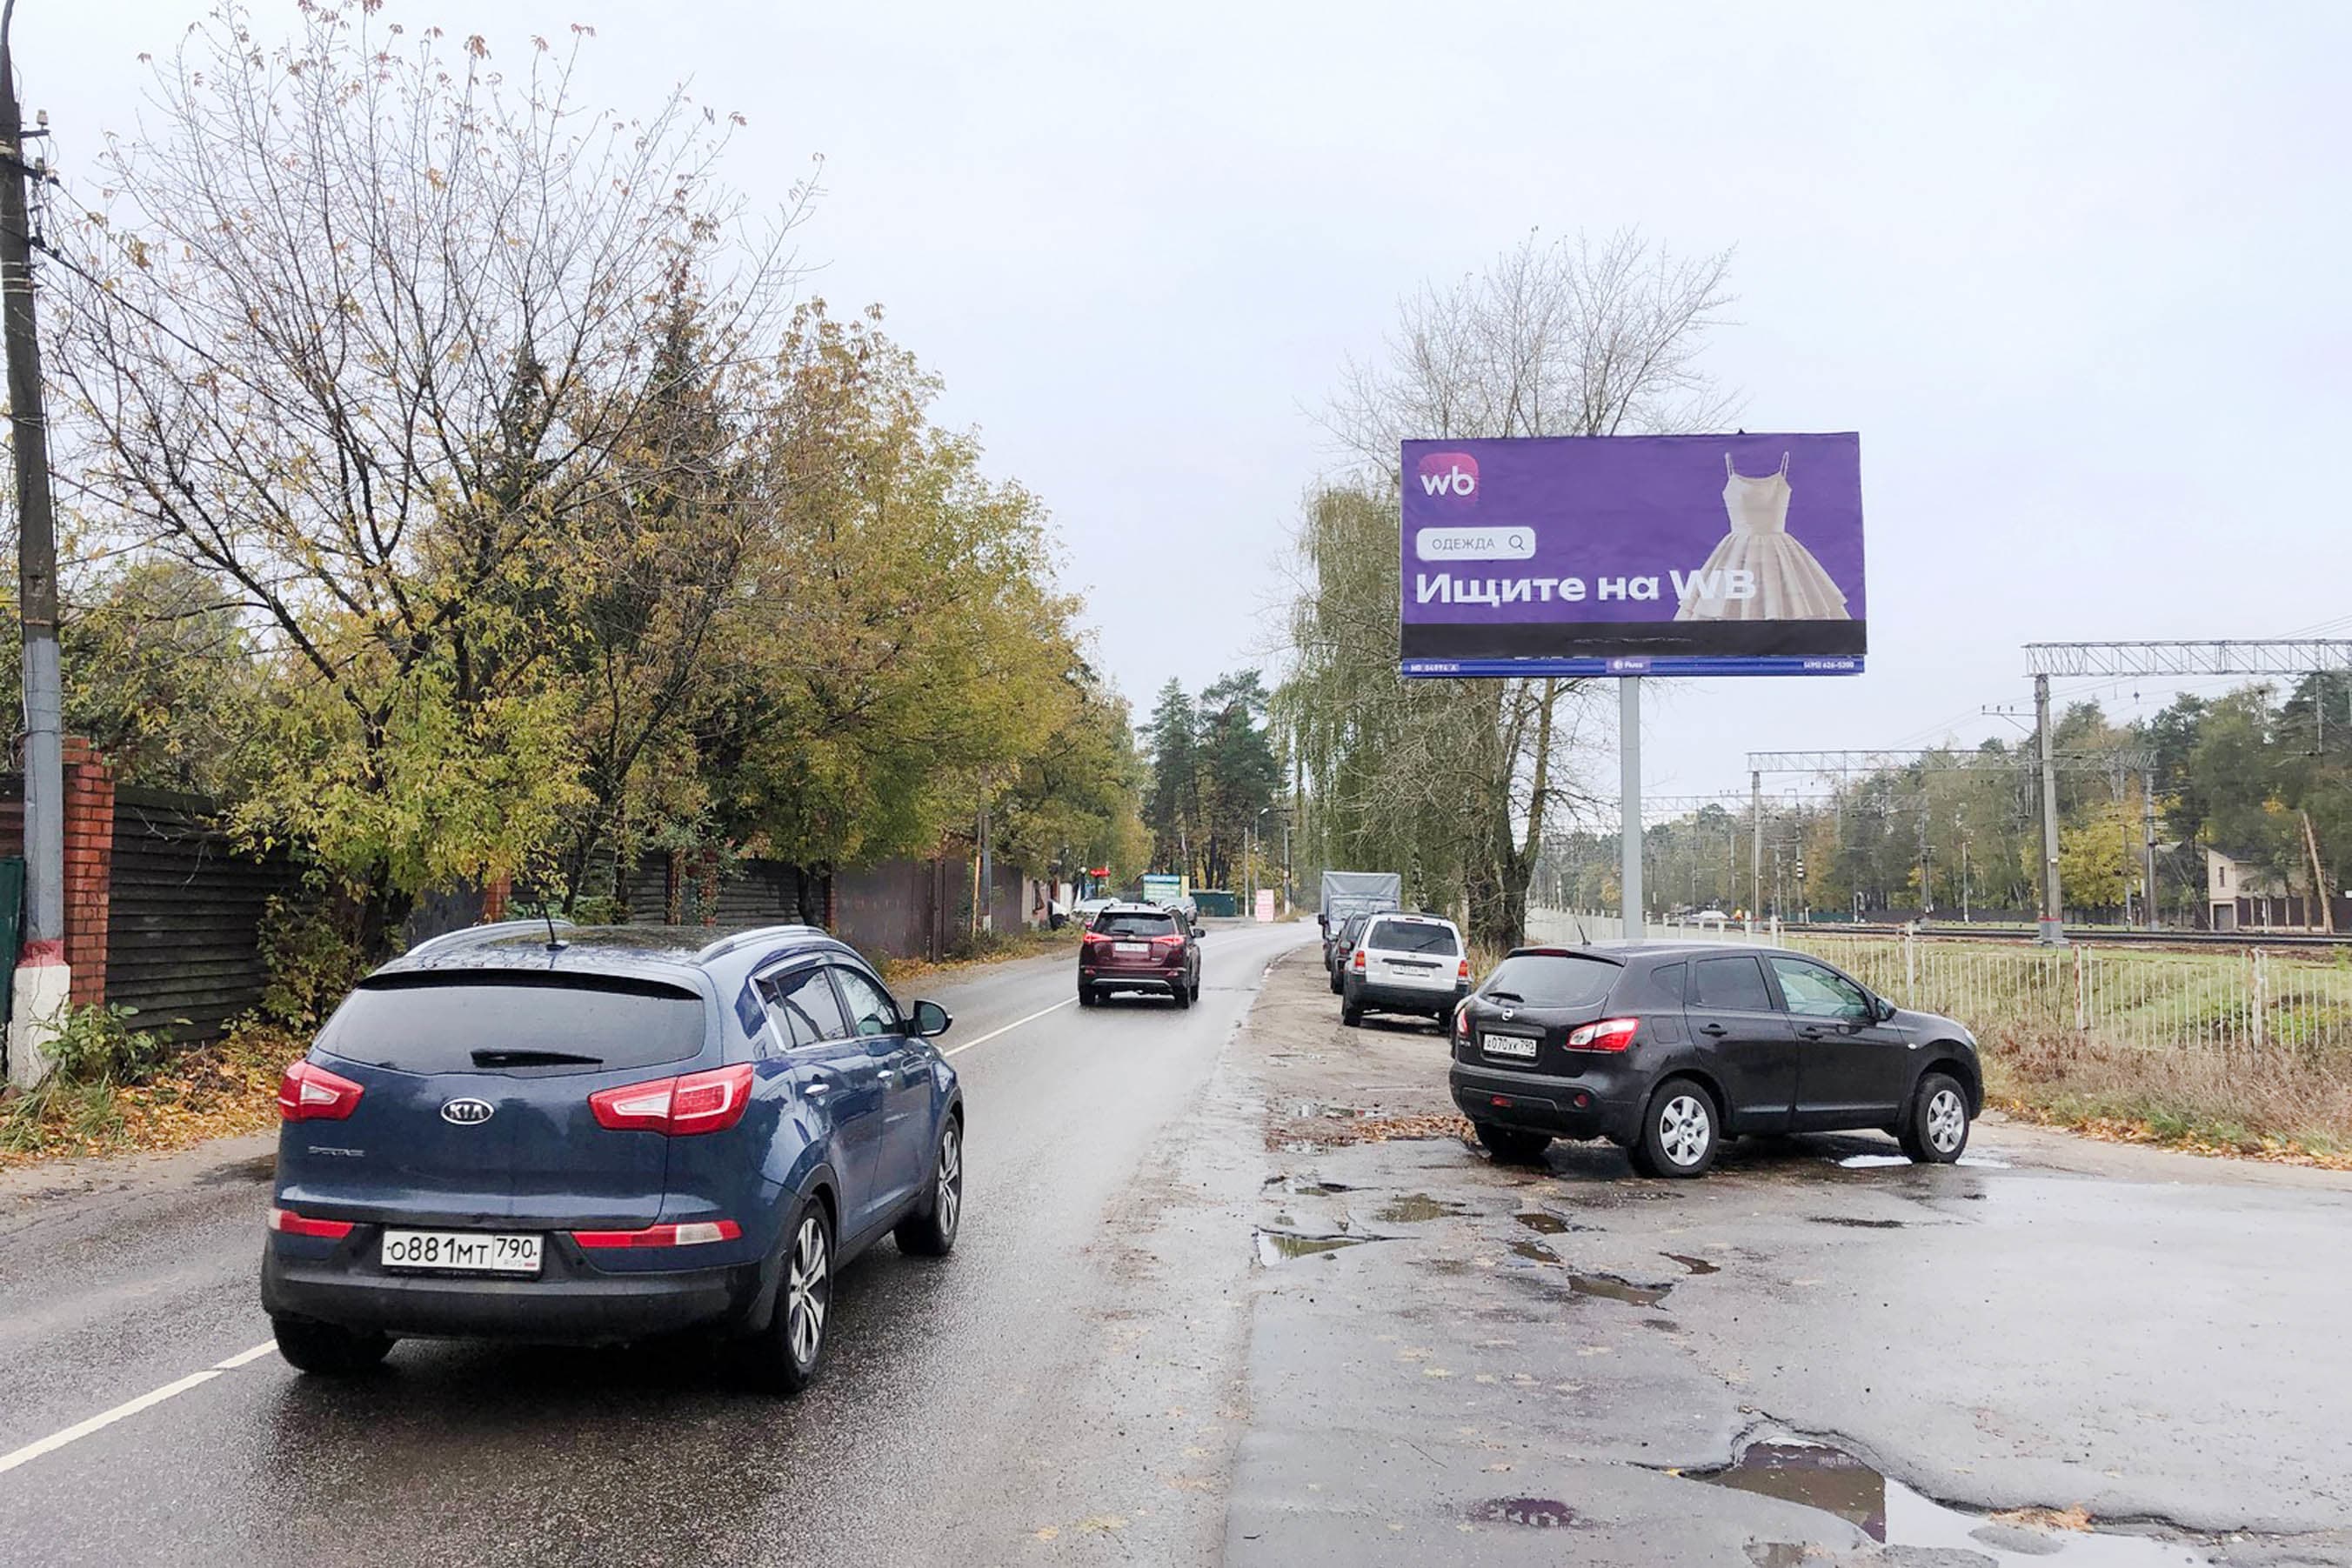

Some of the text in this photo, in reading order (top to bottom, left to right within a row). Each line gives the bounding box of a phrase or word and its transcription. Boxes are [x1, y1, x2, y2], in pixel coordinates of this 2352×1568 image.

[1420, 465, 1475, 496] wb
[1432, 537, 1496, 550] ОДЕЖДА
[1416, 570, 1757, 608] Ищите на WB
[449, 1104, 484, 1119] KIA
[496, 1238, 533, 1259] 790
